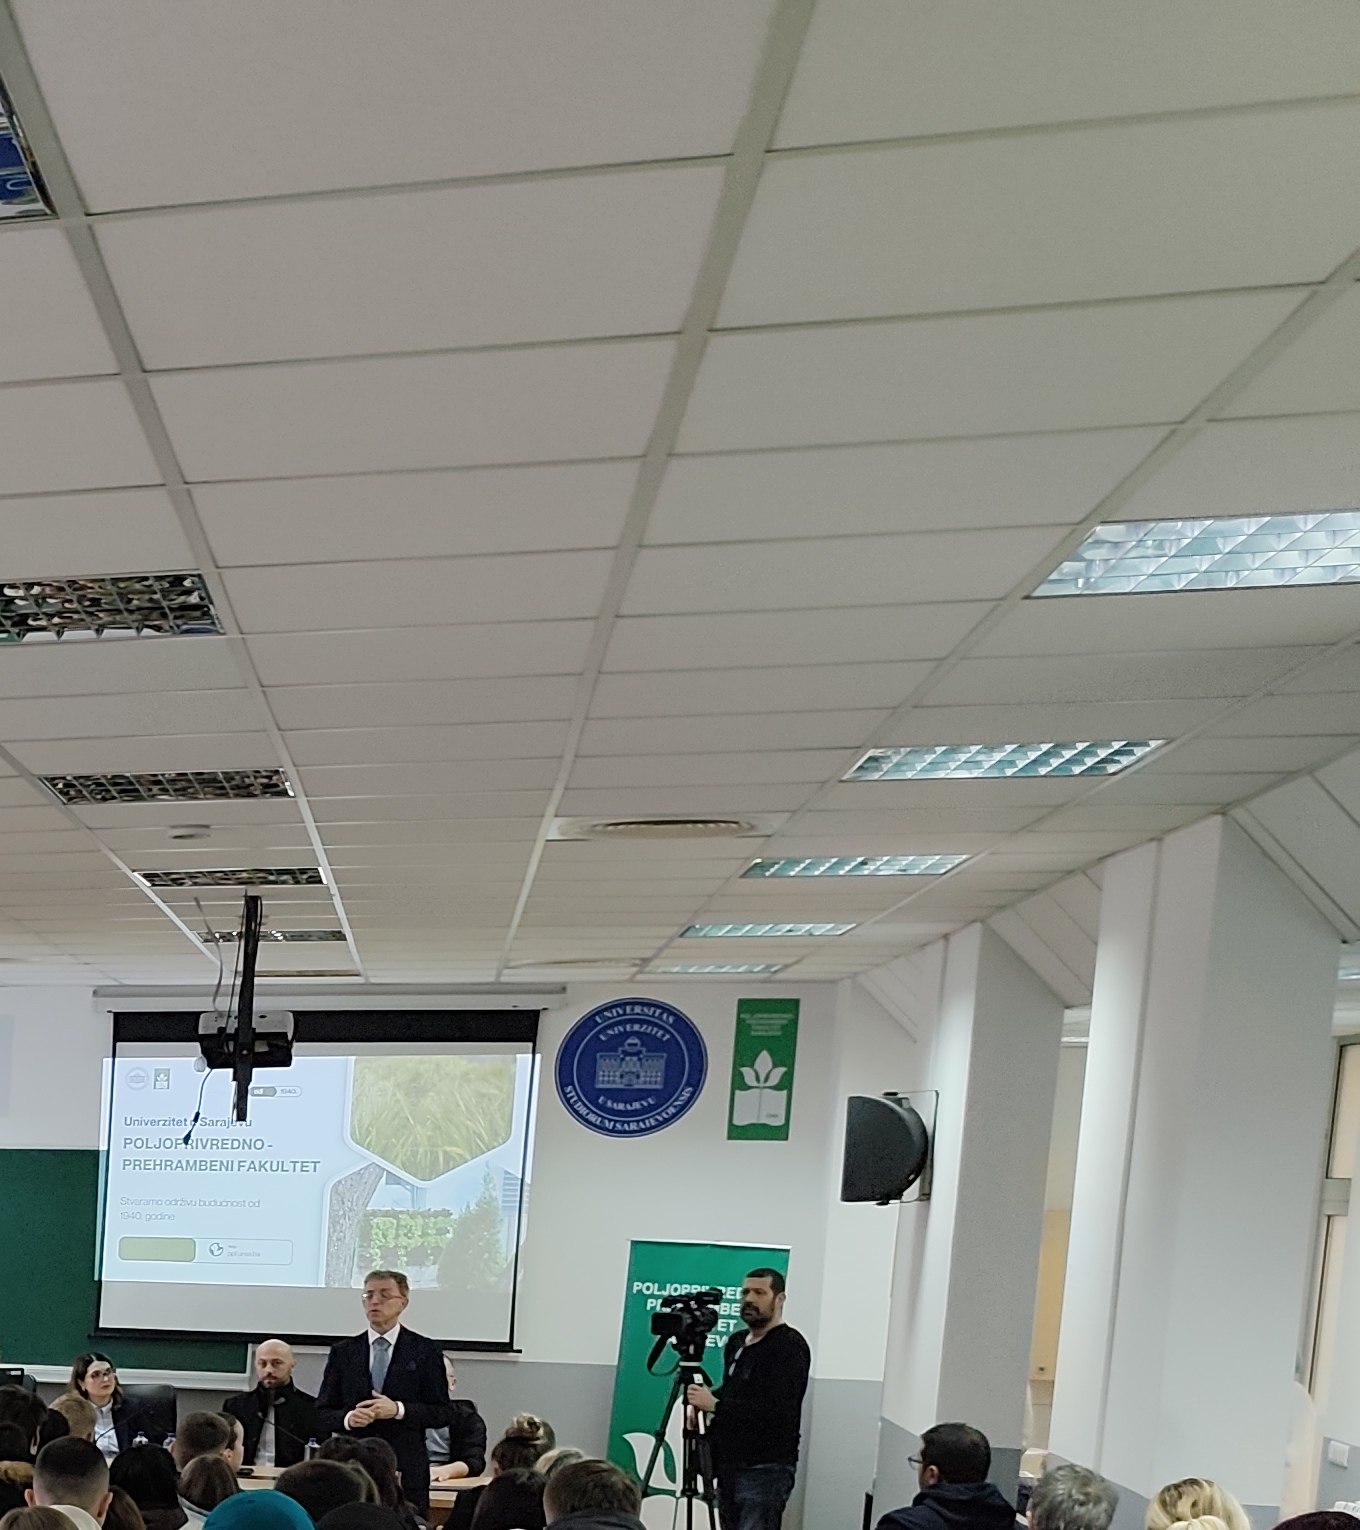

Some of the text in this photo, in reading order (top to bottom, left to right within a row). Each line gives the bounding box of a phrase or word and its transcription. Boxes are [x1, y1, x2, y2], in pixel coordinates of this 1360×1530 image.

[594, 1005, 676, 1025] UNIVERSITAS
[599, 1023, 671, 1042] UNIVERZITET
[563, 1085, 615, 1130] STUDIORUM
[123, 1116, 188, 1127] Univerzitet
[122, 1137, 265, 1151] POLJOPRIVREDNO
[122, 1159, 321, 1173] PREHRAMBENI FAKULTET
[119, 1196, 163, 1207] Stvaramo
[247, 1198, 261, 1208] od
[144, 1211, 176, 1222] godine
